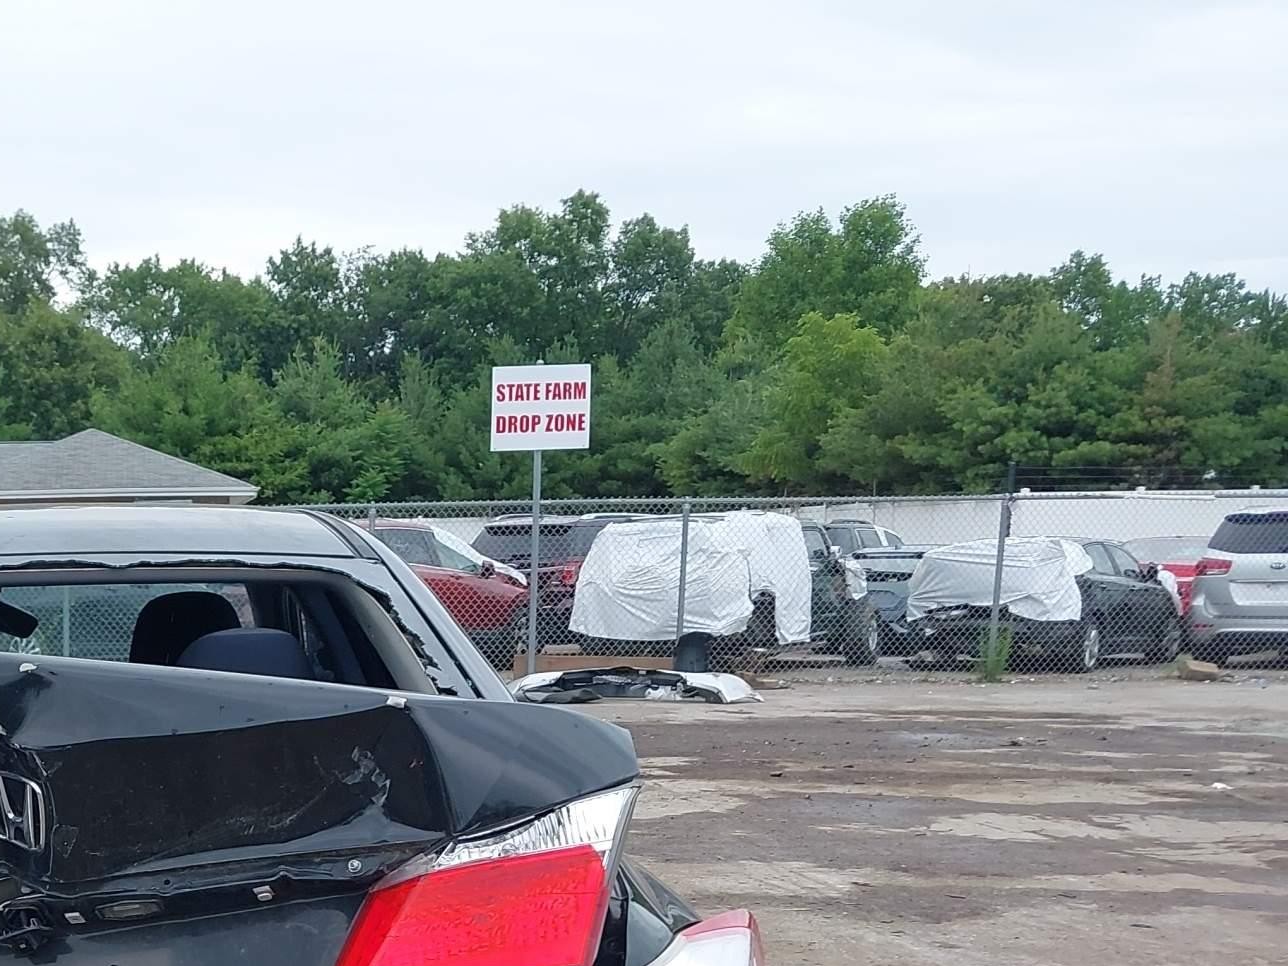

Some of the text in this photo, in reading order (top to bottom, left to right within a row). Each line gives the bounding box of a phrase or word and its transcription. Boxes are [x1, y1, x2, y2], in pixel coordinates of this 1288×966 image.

[496, 381, 587, 402] STATE FARM
[495, 413, 586, 434] DROP ZONE
